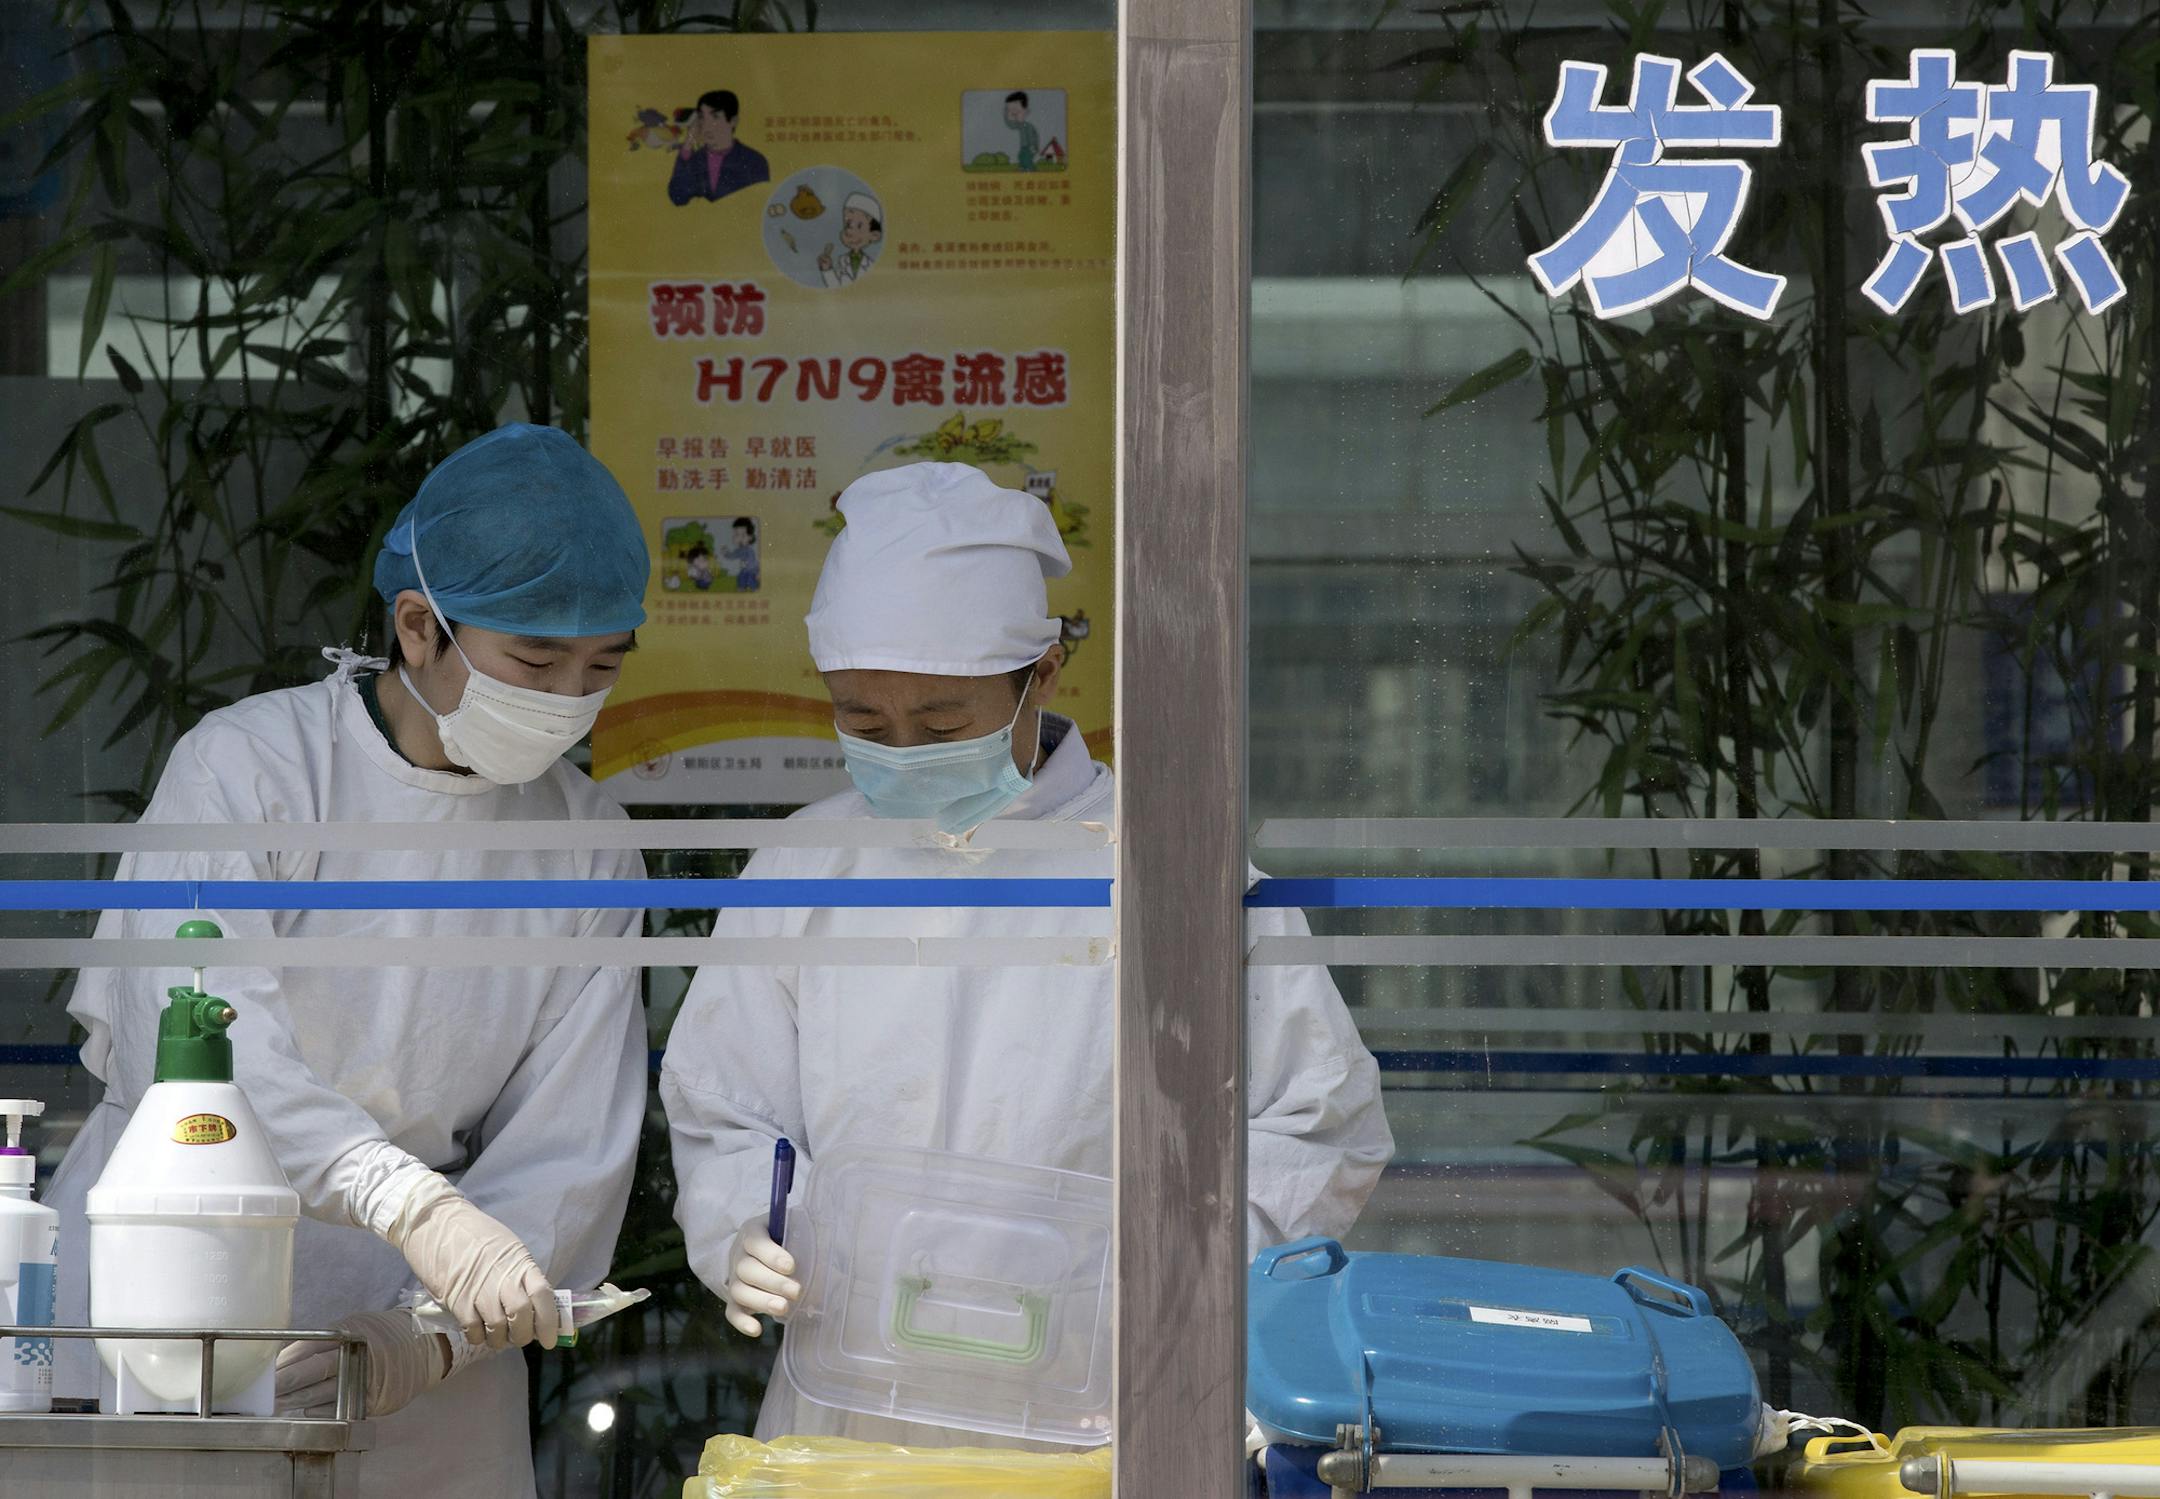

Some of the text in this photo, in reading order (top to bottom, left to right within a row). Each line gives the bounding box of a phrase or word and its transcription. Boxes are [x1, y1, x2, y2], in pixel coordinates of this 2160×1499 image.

[1527, 48, 2131, 320] 发热
[651, 282, 766, 337] 预防
[696, 351, 1068, 406] H7N9禽流感
[656, 436, 817, 459] 早报告 早就医
[657, 466, 817, 491] 勤洗手 勤清洁
